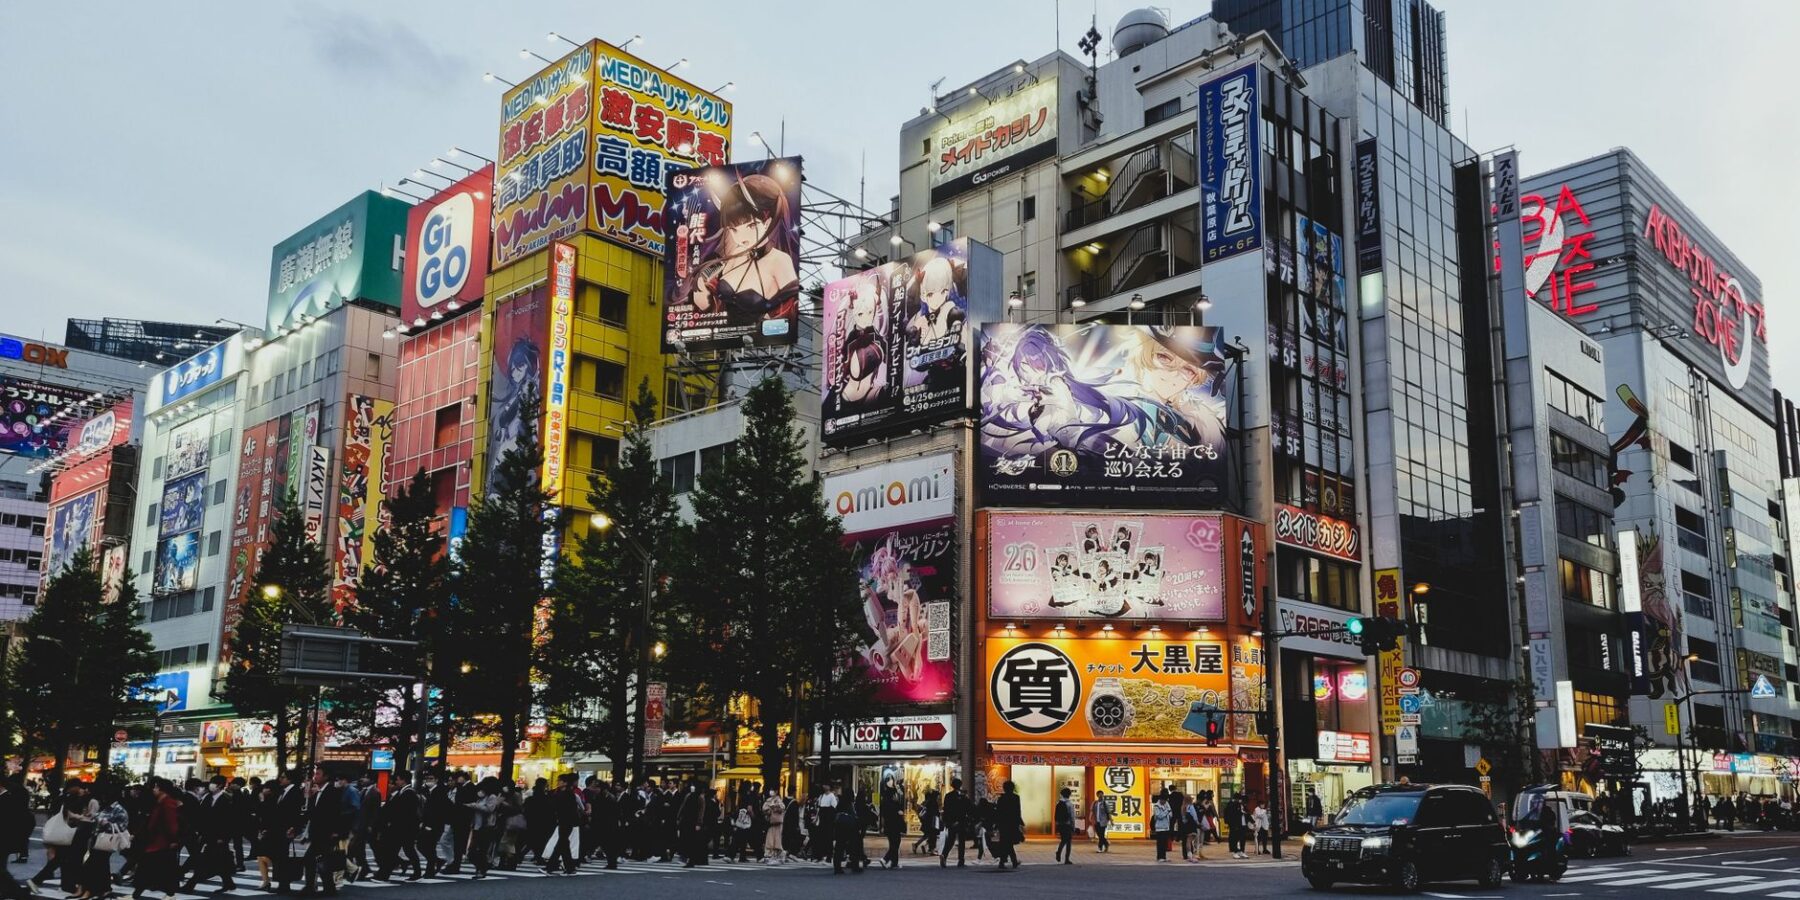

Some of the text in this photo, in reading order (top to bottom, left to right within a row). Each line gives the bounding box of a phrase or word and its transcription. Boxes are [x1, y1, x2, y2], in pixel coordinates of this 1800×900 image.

[501, 82, 589, 166] 激安販売
[600, 86, 727, 167] 激安販売
[940, 107, 1048, 174] メイドカジノ
[497, 127, 586, 213] 高額買取
[1500, 158, 1515, 215] スーパービル
[689, 212, 707, 244] 能代
[1207, 192, 1217, 241] 秋葉原店
[528, 237, 548, 251] AKIBA
[606, 225, 648, 246] ムーラン
[421, 245, 467, 298] GO
[1280, 264, 1294, 284] 7F
[553, 301, 568, 349] ムーラン
[1691, 287, 1739, 365] ZONE
[1283, 347, 1297, 368] 6F
[552, 349, 566, 404] AKIBA
[244, 437, 257, 456] 4F
[1103, 442, 1218, 460] どんな宇宙でも
[1286, 436, 1300, 457] 5F
[309, 449, 326, 500] AKKY
[1104, 461, 1183, 479] 巡り会える
[836, 474, 939, 515] amiami
[237, 505, 249, 524] 3F
[306, 515, 323, 543] Tax
[1276, 509, 1359, 556] メイドカジノ
[1005, 544, 1037, 572] 20
[230, 579, 242, 599] 2F
[1086, 644, 1224, 674] チケット 大黒屋
[1003, 657, 1073, 722] 質
[1402, 674, 1414, 682] 40
[903, 725, 923, 740] ZIN
[1108, 767, 1131, 788] 質
[1104, 795, 1142, 817] 買取
